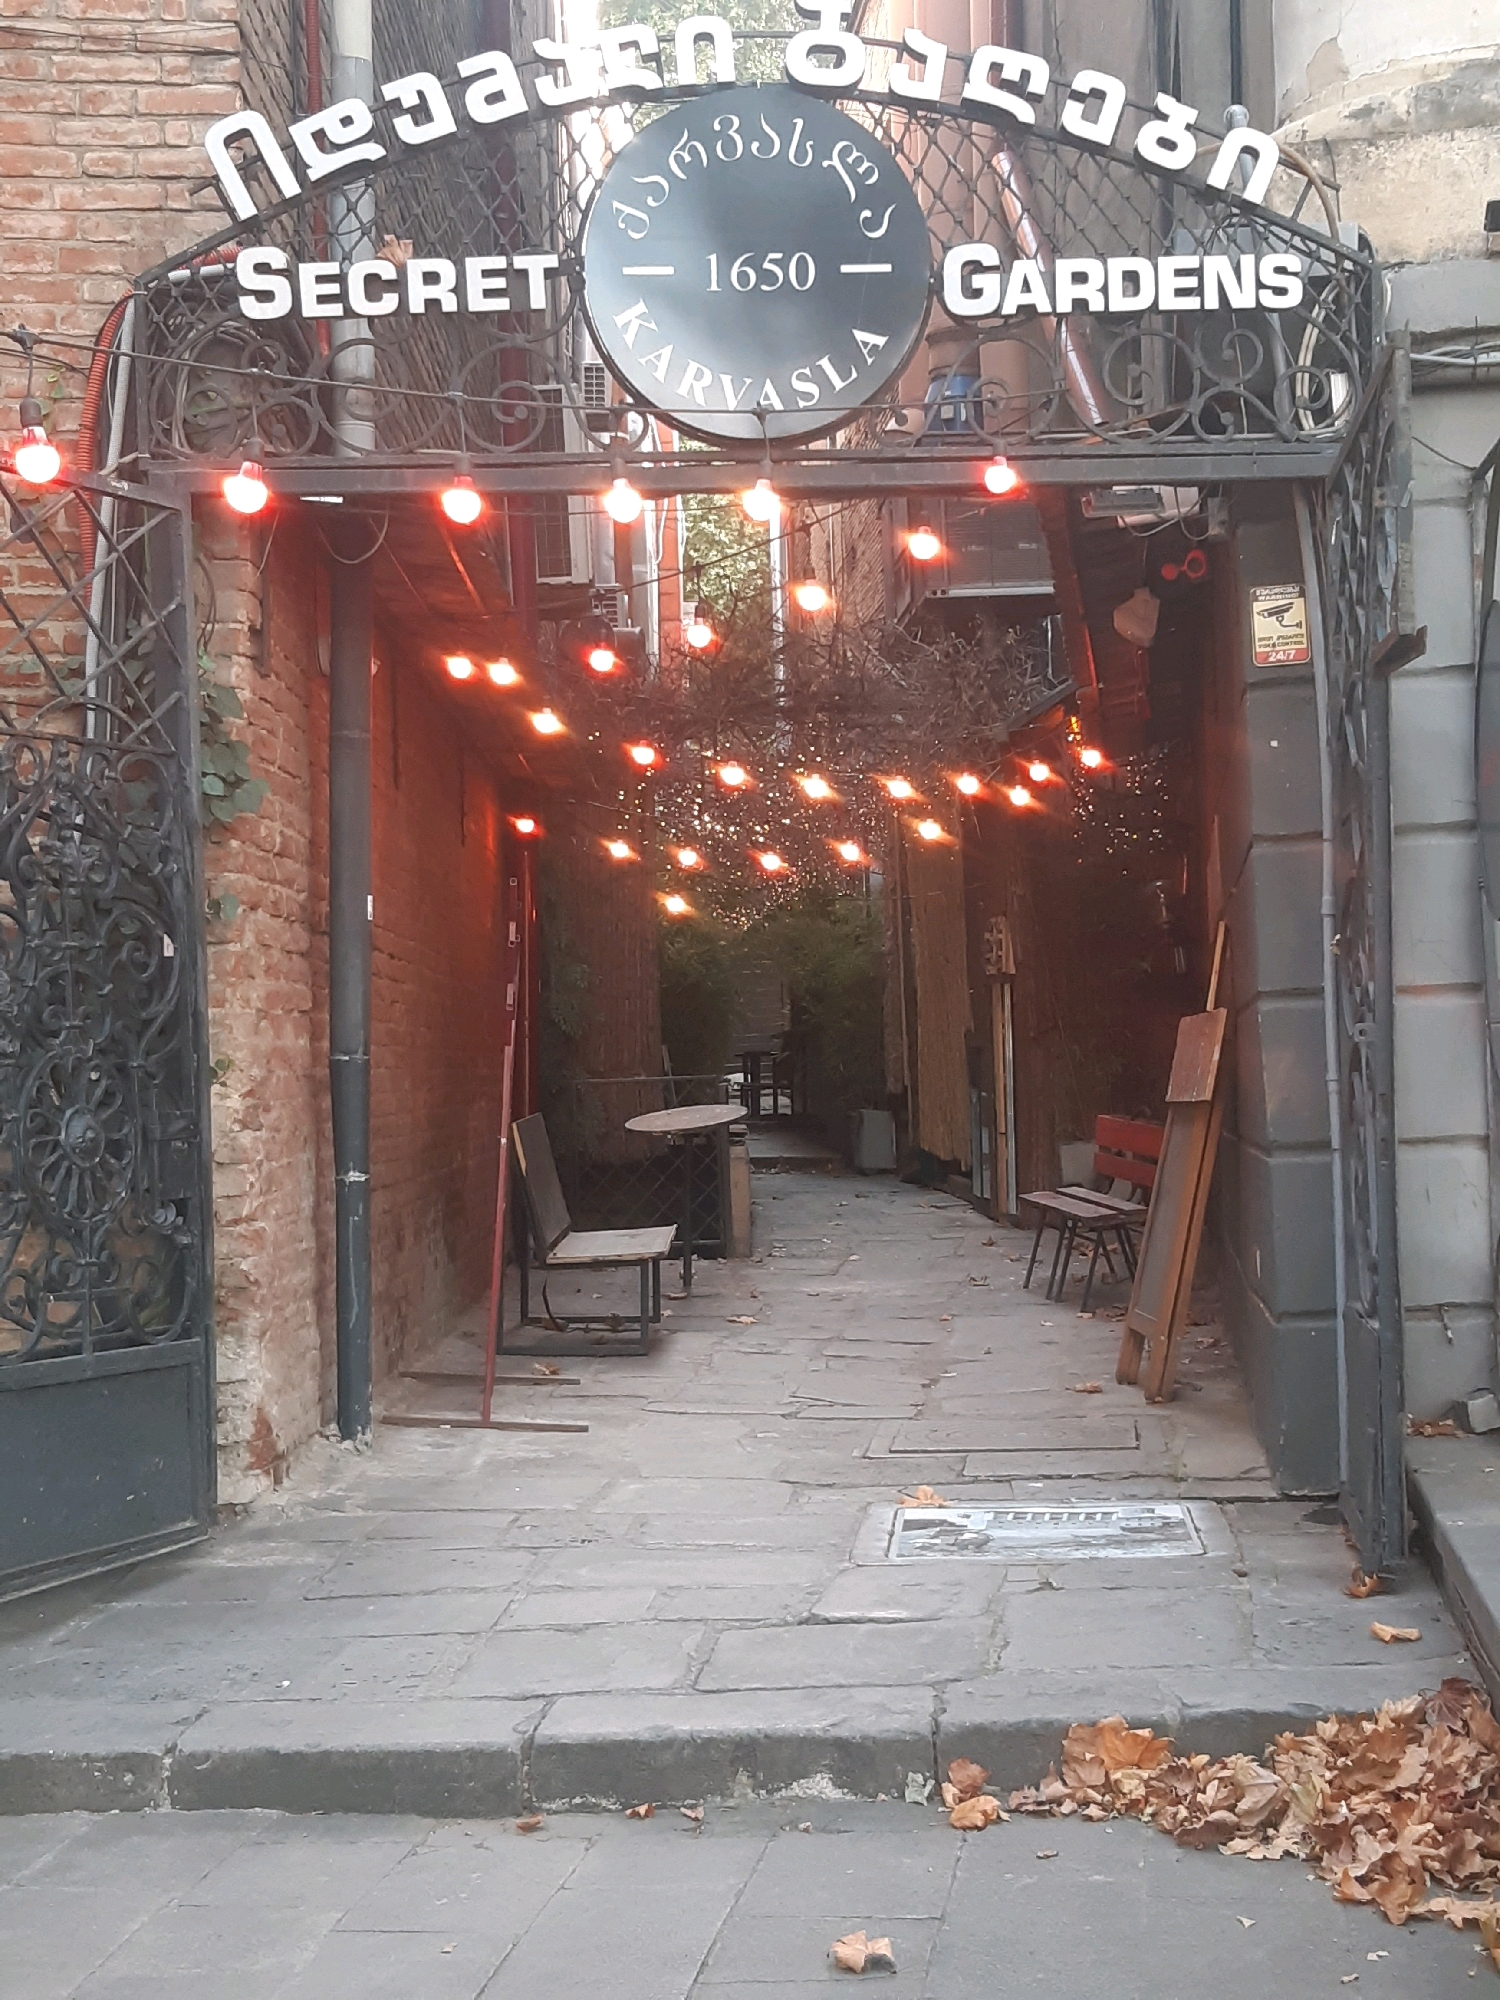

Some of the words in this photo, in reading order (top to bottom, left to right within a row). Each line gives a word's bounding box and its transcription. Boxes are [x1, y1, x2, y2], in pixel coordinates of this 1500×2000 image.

[204, 15, 736, 221] იდუმალი
[785, 0, 1280, 206] ბაღები
[612, 113, 897, 240] ქარვასლა
[236, 246, 559, 320] SECRET
[942, 242, 1302, 317] GARDENS
[705, 252, 816, 292] 1650
[612, 298, 890, 412] KARVASLA
[1269, 650, 1296, 662] 24/7
